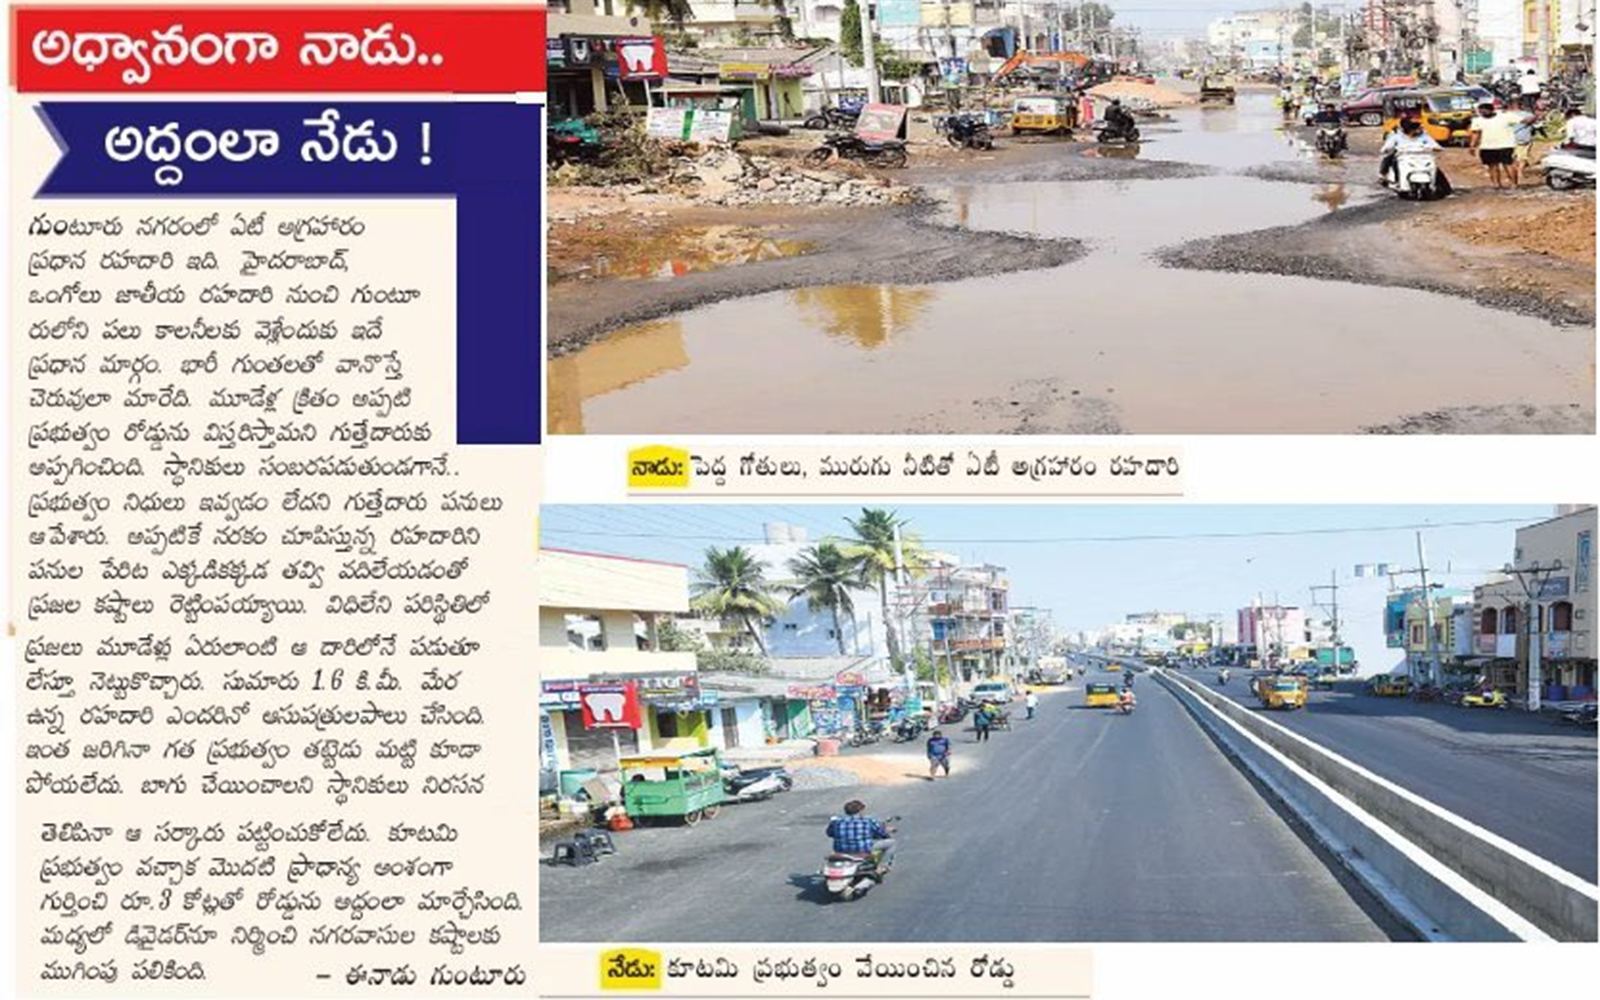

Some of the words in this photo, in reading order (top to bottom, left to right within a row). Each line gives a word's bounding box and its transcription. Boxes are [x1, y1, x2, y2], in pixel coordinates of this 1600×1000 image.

[32, 24, 279, 85] అధ్వానంగా
[299, 23, 443, 65] నాడు..
[105, 122, 279, 185] అద్దంలా
[301, 108, 398, 162] నేడు
[28, 212, 124, 236] గుంటూరు
[135, 212, 219, 236] నగరంలో
[230, 211, 267, 236] ఏటీ
[277, 215, 366, 243] అగ్రహారం
[27, 249, 87, 277] ప్రధాన
[99, 248, 174, 270] రహదారి
[28, 280, 102, 304] ఒంగోలు
[114, 279, 185, 304] జాతీయ
[199, 282, 274, 304] రహదారి
[285, 284, 339, 304] నుంచి
[350, 284, 421, 304] గుంటూ
[28, 316, 89, 340] రులోని
[101, 318, 142, 340] పలు
[154, 316, 241, 340] కాలనీలకు
[351, 315, 383, 341] ఇదే
[27, 352, 87, 381] ప్రధాన
[99, 353, 162, 384] మార్గం.
[180, 350, 218, 376] భారీ
[231, 349, 324, 374] గుంతలతో
[335, 349, 404, 381] వానొస్తే
[29, 387, 112, 412] చెరువులా
[123, 383, 191, 408] మారేది.
[292, 387, 340, 415] క్రితం
[352, 387, 412, 418] అప్పటి
[27, 420, 111, 452] ప్రభుత్వం
[123, 418, 190, 451] రోడ్డును
[203, 417, 317, 450] విస్తరిస్తామని
[329, 418, 432, 450] గుత్తేదారుకు
[29, 454, 145, 486] అప్పగించింది.
[163, 451, 246, 488] స్థానికులు
[690, 455, 726, 485] పెద్ద
[740, 453, 807, 477] గోతులు,
[820, 456, 891, 476] మురుగు
[903, 453, 954, 476] నీటితో
[966, 450, 999, 476] ఏటీ
[1012, 456, 1096, 481] అగ్రహారం
[1110, 455, 1179, 476] రహదారి
[27, 490, 110, 522] ప్రభుత్వం
[123, 491, 186, 513] నిధులు
[199, 491, 268, 522] ఇవ్వడం
[281, 487, 331, 512] లేదని
[343, 487, 427, 519] గుత్తేదారు
[440, 490, 504, 512] పనులు
[127, 521, 203, 556] అప్పటికే
[212, 525, 268, 545] నరకం
[281, 524, 377, 556] చూపిస్తున్న
[390, 524, 481, 545] రహదారిని
[28, 558, 84, 580] పనుల
[99, 556, 149, 580] పేరిట
[161, 558, 270, 589] ఎక్కడికక్కడ
[281, 559, 325, 589] తవ్వి
[338, 556, 469, 580] వదిలేయడంతో
[27, 593, 81, 621] ప్రజల
[93, 589, 154, 624] కష్టాలు
[169, 592, 307, 624] రెట్టింపయ్యాయి.
[325, 590, 393, 615] విధిలేని
[403, 590, 491, 625] పరిస్థితిలో
[24, 635, 83, 664] ప్రజలు
[184, 633, 278, 657] ఏరులాంటి
[290, 642, 308, 657] ఆ
[319, 633, 398, 657] దారిలోనే
[409, 635, 481, 657] పడుతూ
[25, 667, 76, 698] లేస్తూ
[89, 670, 204, 701] నెట్టుకొచ్చారు.
[222, 669, 300, 691] సుమారు
[420, 667, 462, 691] మేర
[26, 704, 66, 735] ఉన్న
[79, 703, 154, 725] రహదారి
[166, 701, 251, 725] ఎందరినో
[262, 700, 408, 732] ఆసుపత్రులపాలు
[25, 739, 71, 760] ఇంత
[82, 740, 151, 759] జరిగినా
[163, 738, 197, 759] గత
[206, 737, 291, 769] ప్రభుత్వం
[303, 739, 362, 769] తట్టెడు
[375, 738, 417, 770] మట్టి
[429, 738, 482, 759] కూడా
[25, 770, 124, 794] పోయలేదు.
[140, 774, 187, 794] బాగు
[201, 771, 314, 795] చేయించాలని
[326, 769, 410, 806] స్థానికులు
[422, 773, 485, 794] నిరసన
[40, 821, 113, 842] తెలిపినా
[125, 828, 142, 842] ఆ
[154, 821, 225, 852] సర్కారు
[236, 818, 370, 852] పట్టించుకోలేదు.
[387, 822, 458, 842] కూటమి
[39, 855, 123, 886] ప్రభుత్వం
[135, 856, 201, 886] వచ్చాక
[208, 855, 276, 877] మొదటి
[286, 852, 361, 887] ప్రాధాన్య
[373, 856, 454, 877] అంశంగా
[39, 890, 108, 918] గుర్తించి
[182, 886, 244, 916] కోట్లతో
[255, 887, 322, 921] రోడ్డును
[334, 890, 405, 921] అద్దంలా
[417, 886, 523, 920] మార్చేసింది.
[40, 920, 113, 956] మధ్యలో
[230, 925, 298, 956] నిర్మించి
[308, 923, 416, 945] నగరవాసుల
[428, 920, 501, 955] కష్టాలకు
[40, 958, 118, 984] ముగింపు
[345, 963, 417, 986] ఈనాడు
[429, 963, 526, 986] గుంటూరు
[667, 957, 738, 978] కూటమి
[753, 958, 841, 988] ప్రభుత్వం
[855, 954, 956, 978] వేయించిన
[970, 954, 1014, 988] రోడ్డు
